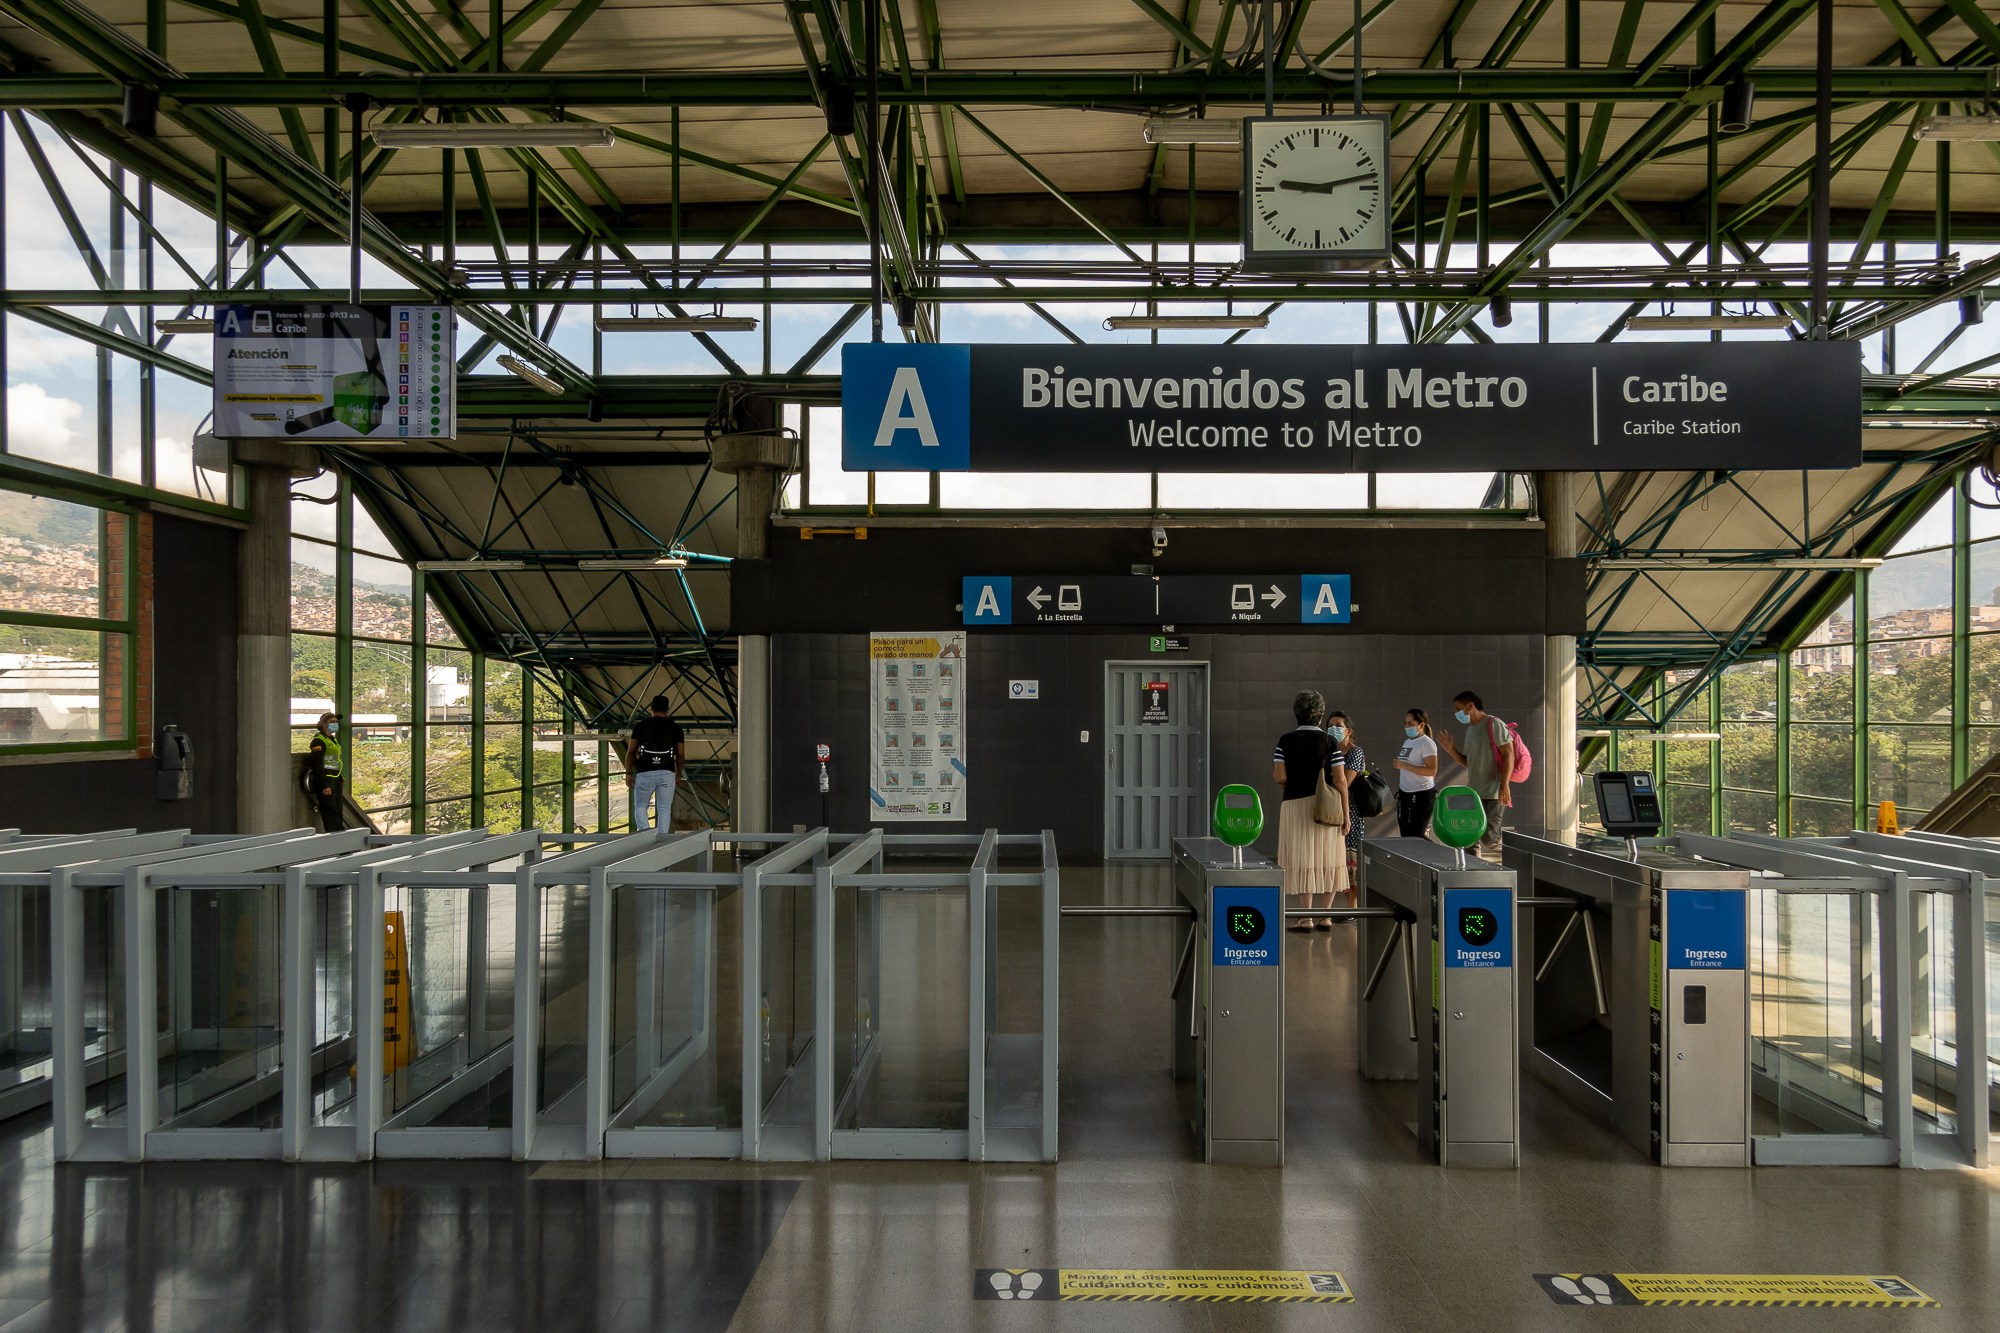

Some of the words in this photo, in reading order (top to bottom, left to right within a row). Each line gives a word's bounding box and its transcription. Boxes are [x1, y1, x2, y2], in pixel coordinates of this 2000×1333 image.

[223, 310, 241, 333] A
[276, 323, 308, 333] Caribe
[228, 348, 289, 360] Atención
[1022, 366, 1305, 410] Bienvenidos
[1325, 369, 1369, 409] al
[1387, 368, 1528, 409] Metro
[1623, 375, 1728, 403] Caribe
[873, 367, 940, 447] A
[1128, 419, 1268, 448] Welcome
[1284, 422, 1314, 448] to
[1327, 419, 1422, 448] Metro
[1623, 420, 1675, 435] Caribe
[1682, 420, 1741, 435] Station
[975, 585, 1001, 616] A
[1313, 583, 1339, 615] A
[1239, 612, 1261, 621] Niquía
[928, 802, 940, 811] 25
[1224, 947, 1268, 960] Ingreso
[1456, 949, 1501, 961] Ingreso
[1684, 948, 1727, 960] Ingreso
[1063, 1280, 1171, 1290] ¡Cuidándote,
[1177, 1281, 1208, 1289] nos
[1216, 1281, 1304, 1290] cuidamos!
[1787, 1287, 1879, 1295] cuidamos!
